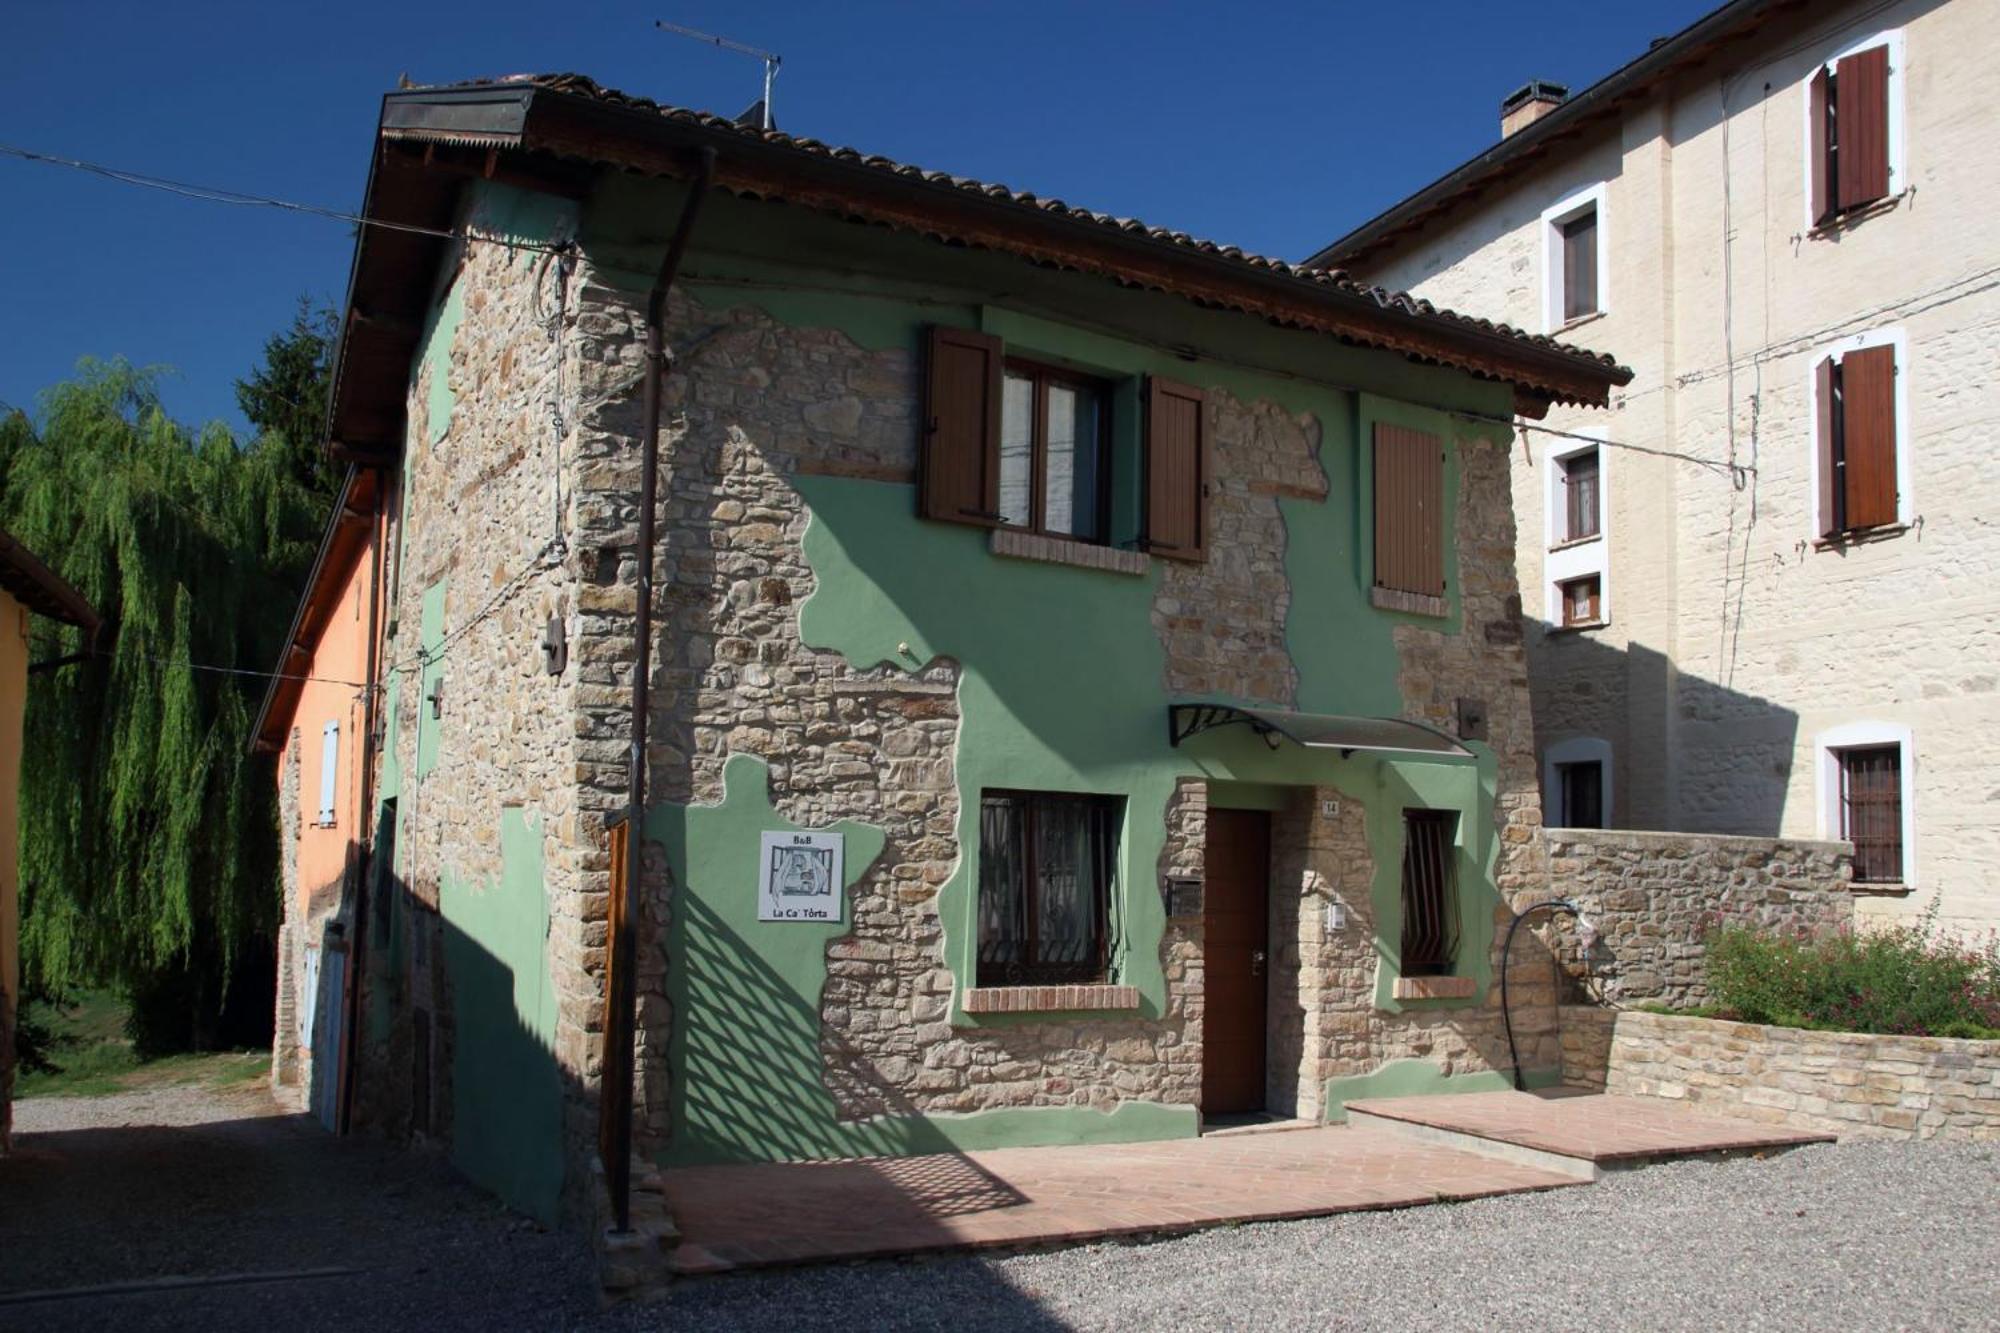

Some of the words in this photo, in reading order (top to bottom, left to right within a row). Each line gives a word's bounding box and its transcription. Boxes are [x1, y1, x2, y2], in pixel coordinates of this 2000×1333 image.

[1327, 803, 1336, 812] 14
[793, 835, 812, 845] B&B
[773, 909, 783, 918] La
